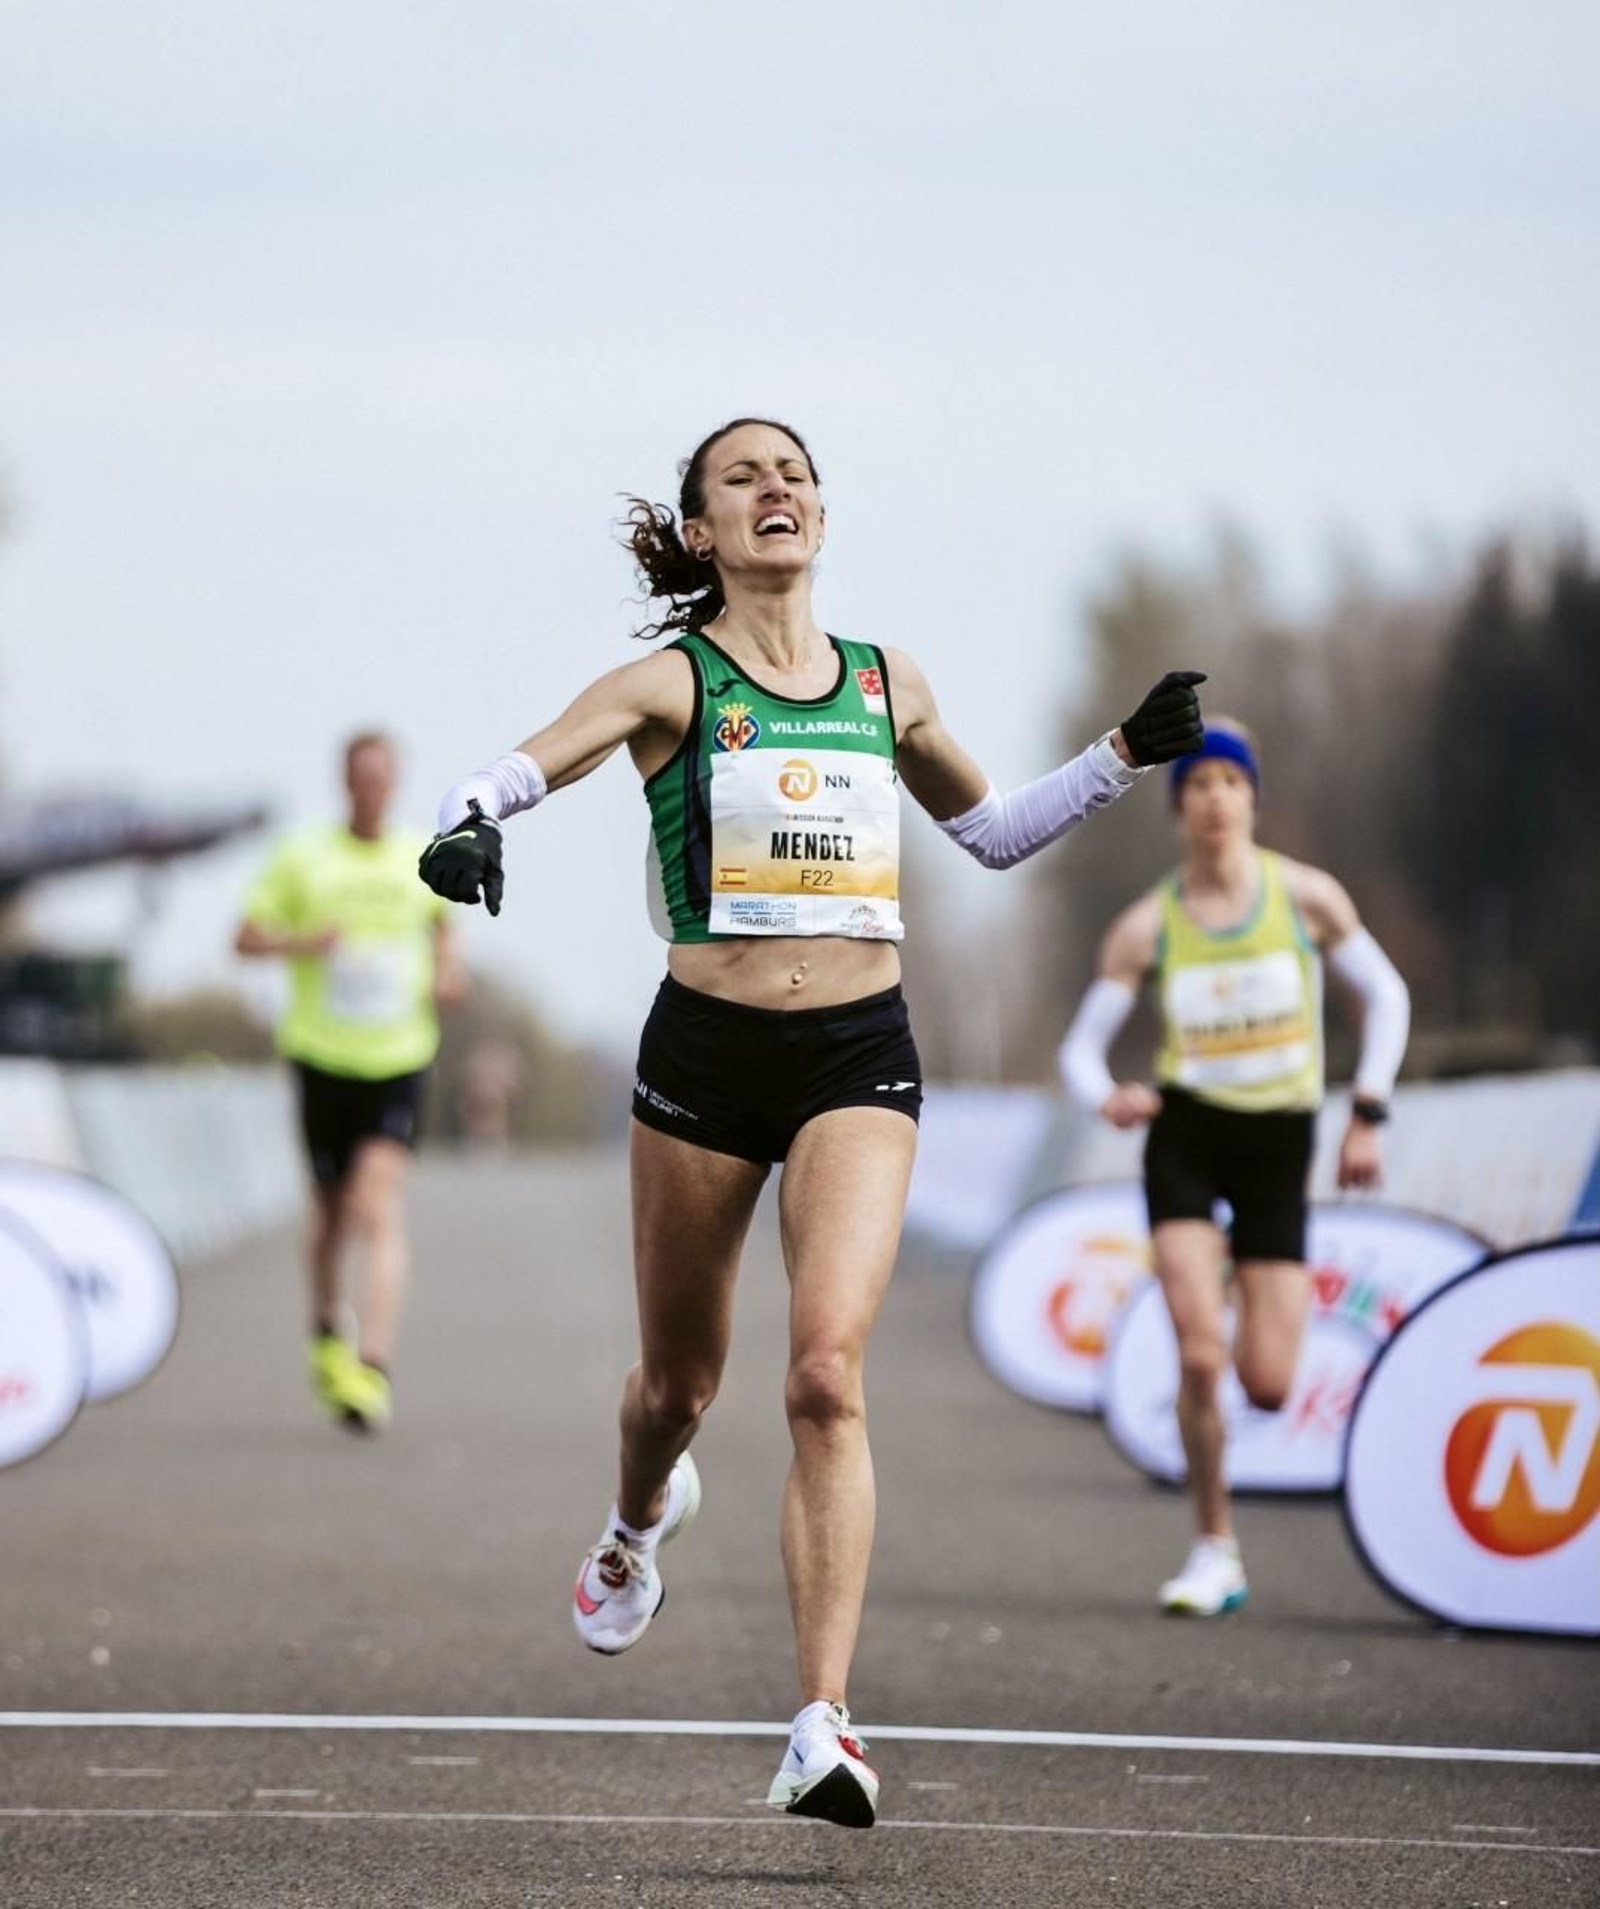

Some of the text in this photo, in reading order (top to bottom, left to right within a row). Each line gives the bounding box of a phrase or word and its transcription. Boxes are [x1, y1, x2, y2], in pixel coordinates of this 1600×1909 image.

[769, 721, 861, 735] VILLARREAL
[825, 774, 851, 789] NN
[771, 832, 856, 861] MENDEZ
[801, 870, 834, 887] F22
[730, 901, 797, 911] MARATHON
[730, 916, 797, 927] HAMBURG
